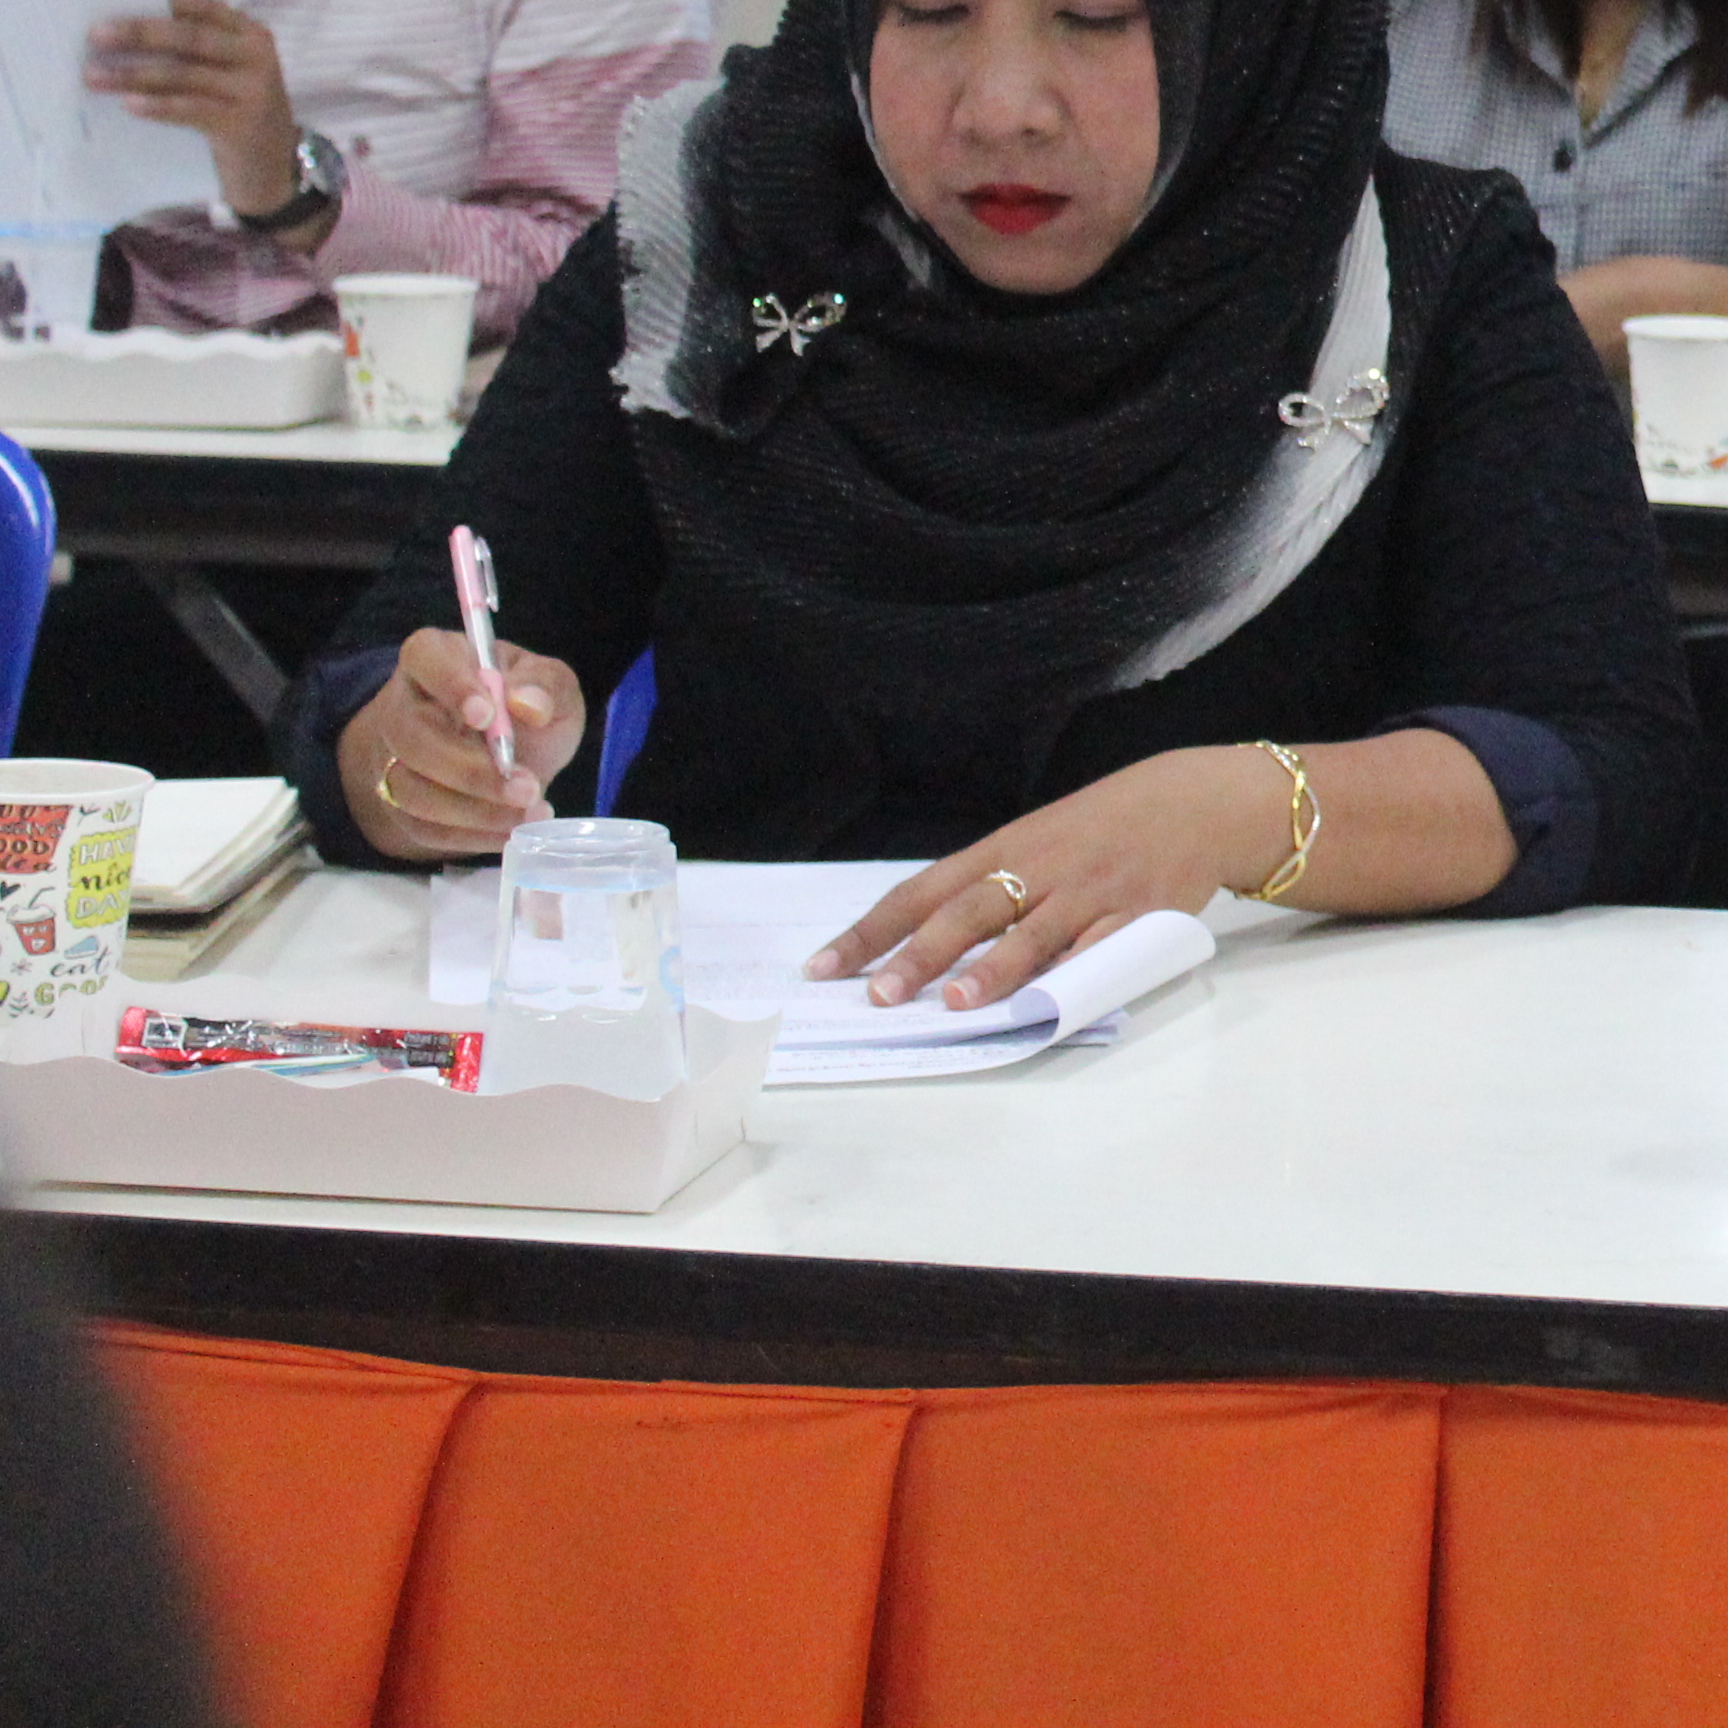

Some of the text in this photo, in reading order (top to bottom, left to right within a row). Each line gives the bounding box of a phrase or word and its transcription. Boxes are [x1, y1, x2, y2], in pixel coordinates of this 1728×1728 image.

[79, 834, 137, 866] HAV
[80, 862, 132, 891] nic
[50, 945, 110, 978] eat
